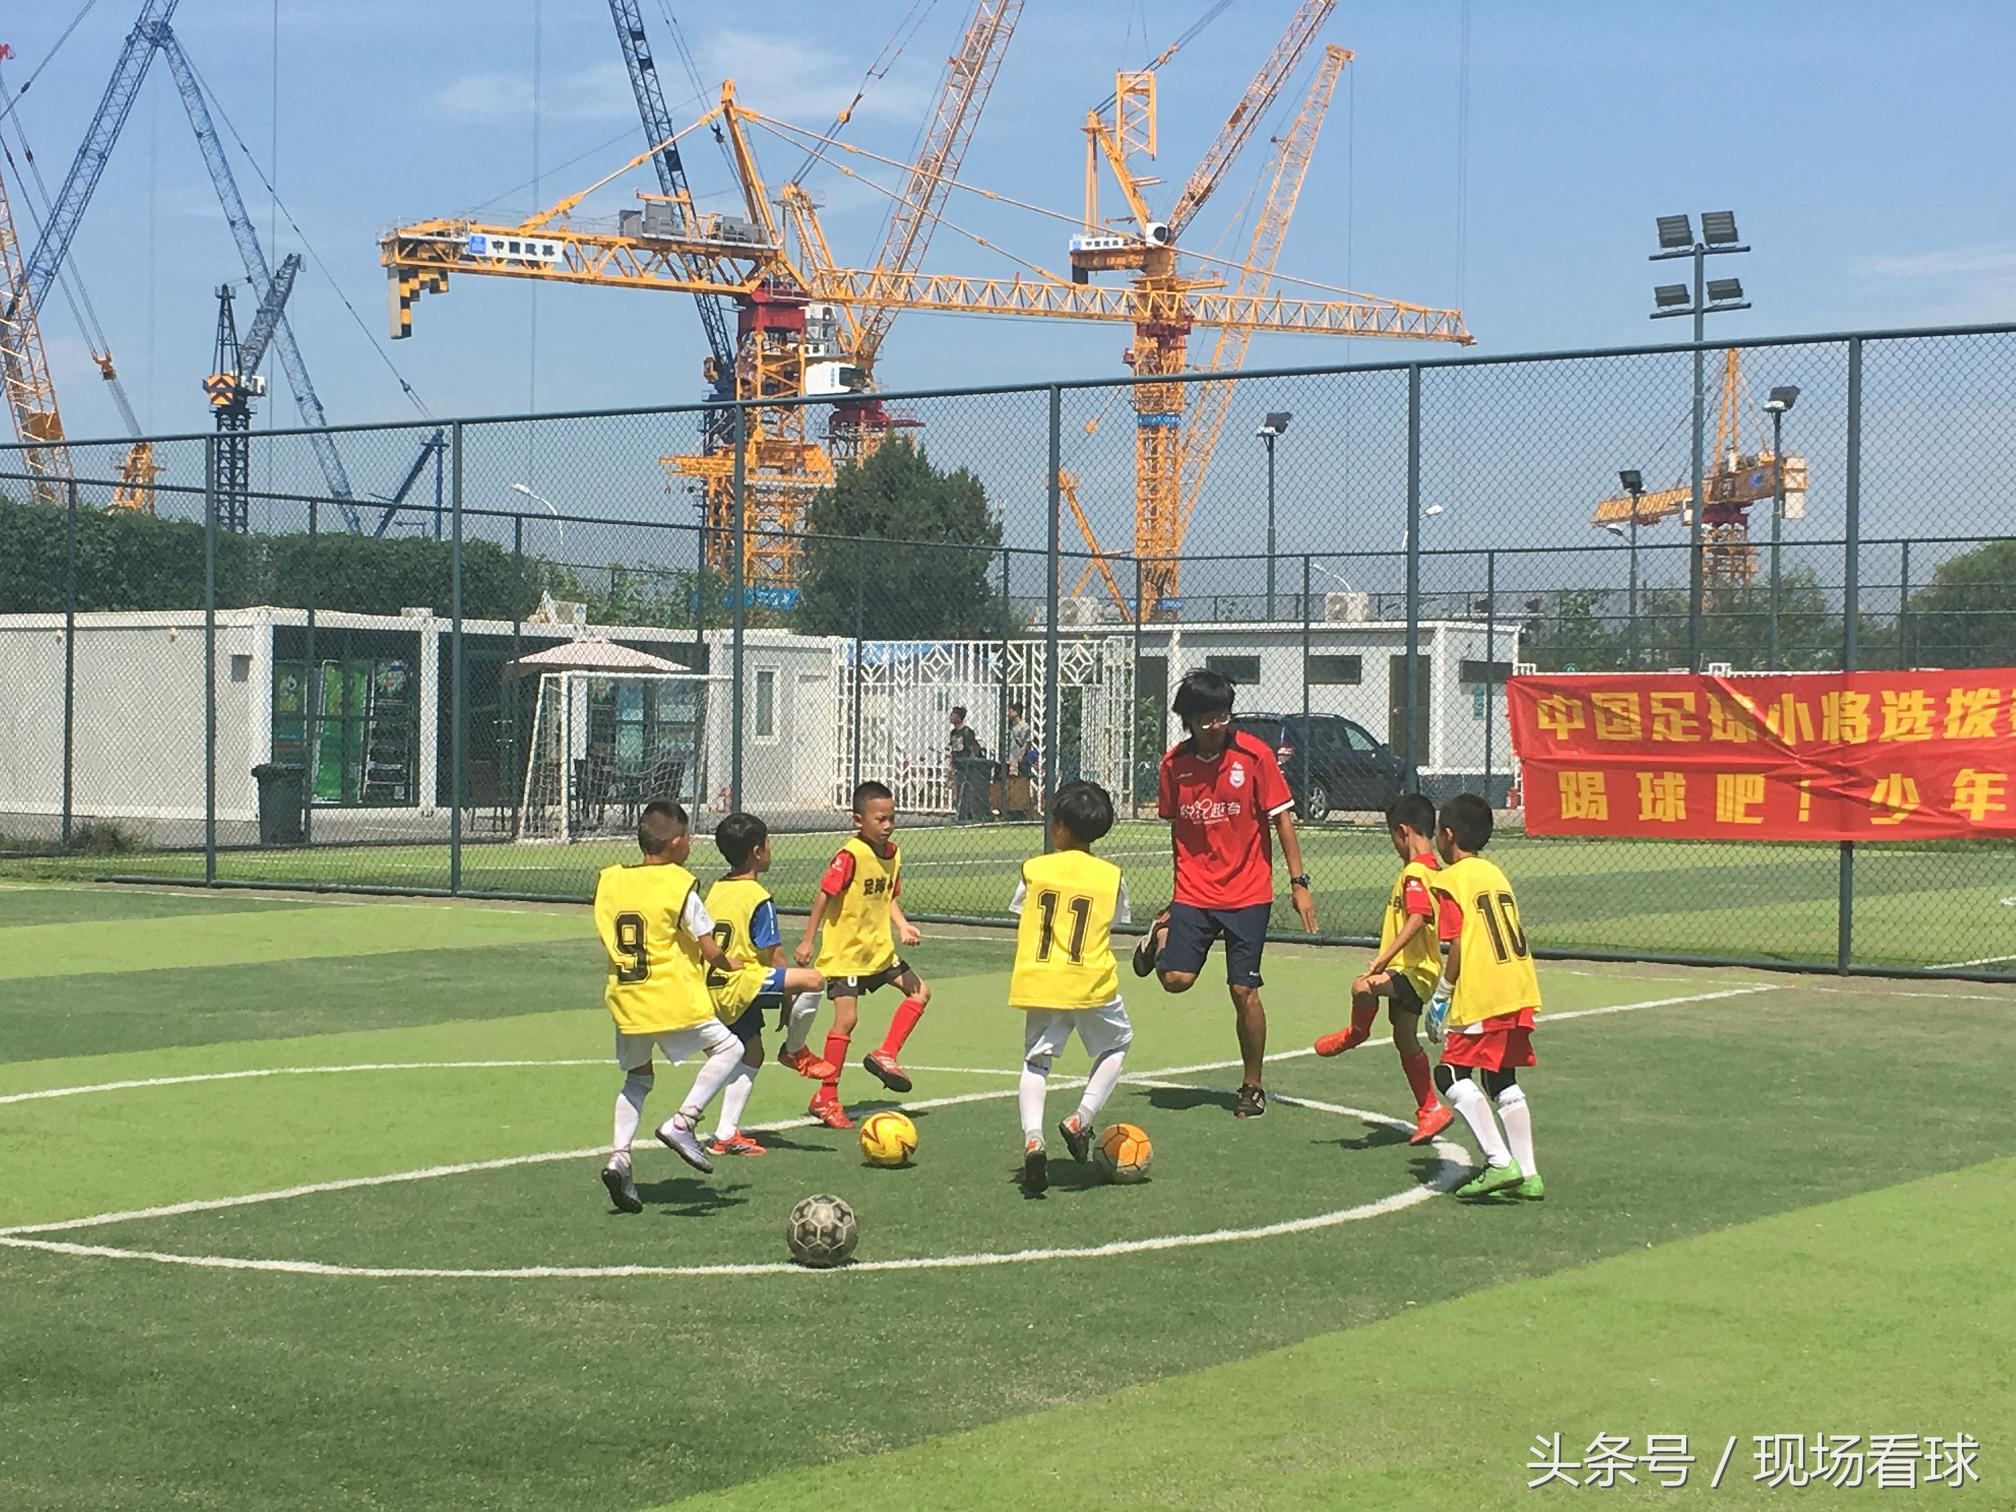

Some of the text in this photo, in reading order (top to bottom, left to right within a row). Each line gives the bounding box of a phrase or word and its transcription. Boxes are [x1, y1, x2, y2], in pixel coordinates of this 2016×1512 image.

[1535, 687, 2016, 746] 中国足球小将选拨
[614, 911, 652, 985] 9
[706, 919, 736, 990] 2
[1036, 889, 1094, 966] 11
[1473, 890, 1530, 965] 10
